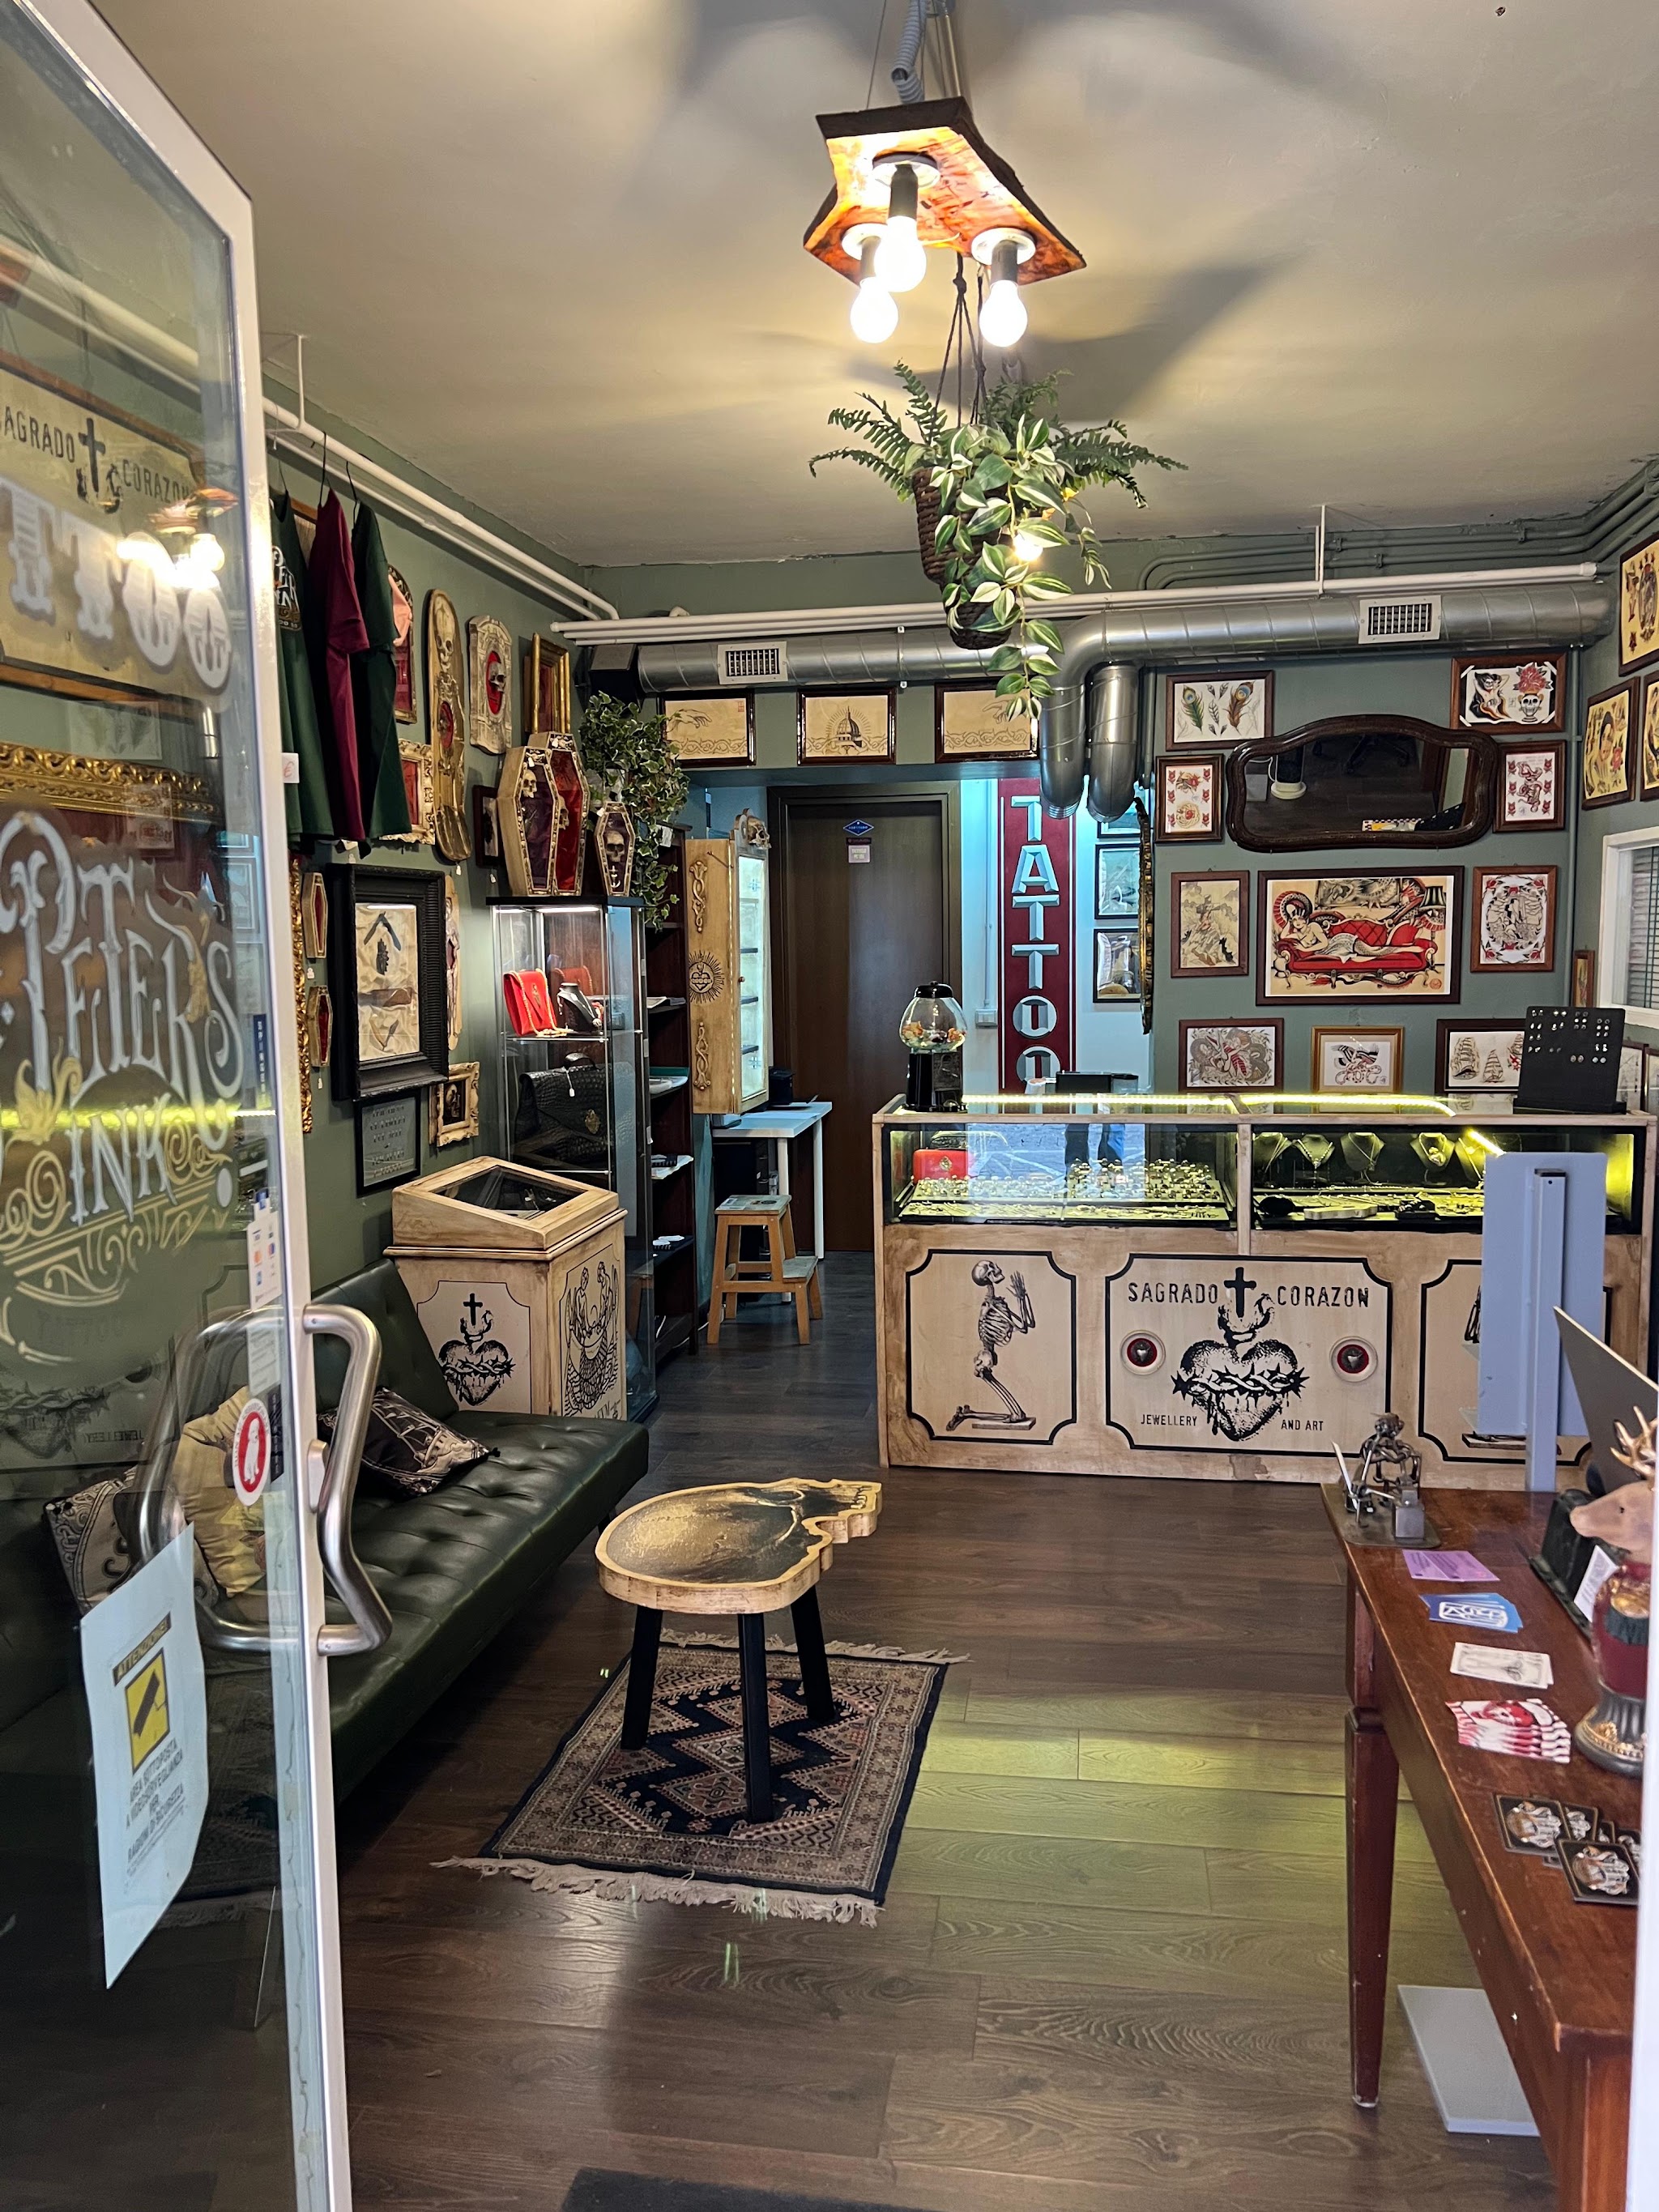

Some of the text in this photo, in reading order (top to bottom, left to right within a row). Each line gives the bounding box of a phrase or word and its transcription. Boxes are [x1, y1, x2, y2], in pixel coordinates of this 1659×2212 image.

[0, 405, 75, 463] AGRADO
[1011, 795, 1061, 1087] TATTOO
[1128, 1282, 1369, 1308] SAGRADO CORAZON
[1141, 1414, 1324, 1431] JEWELLERY AND ART
